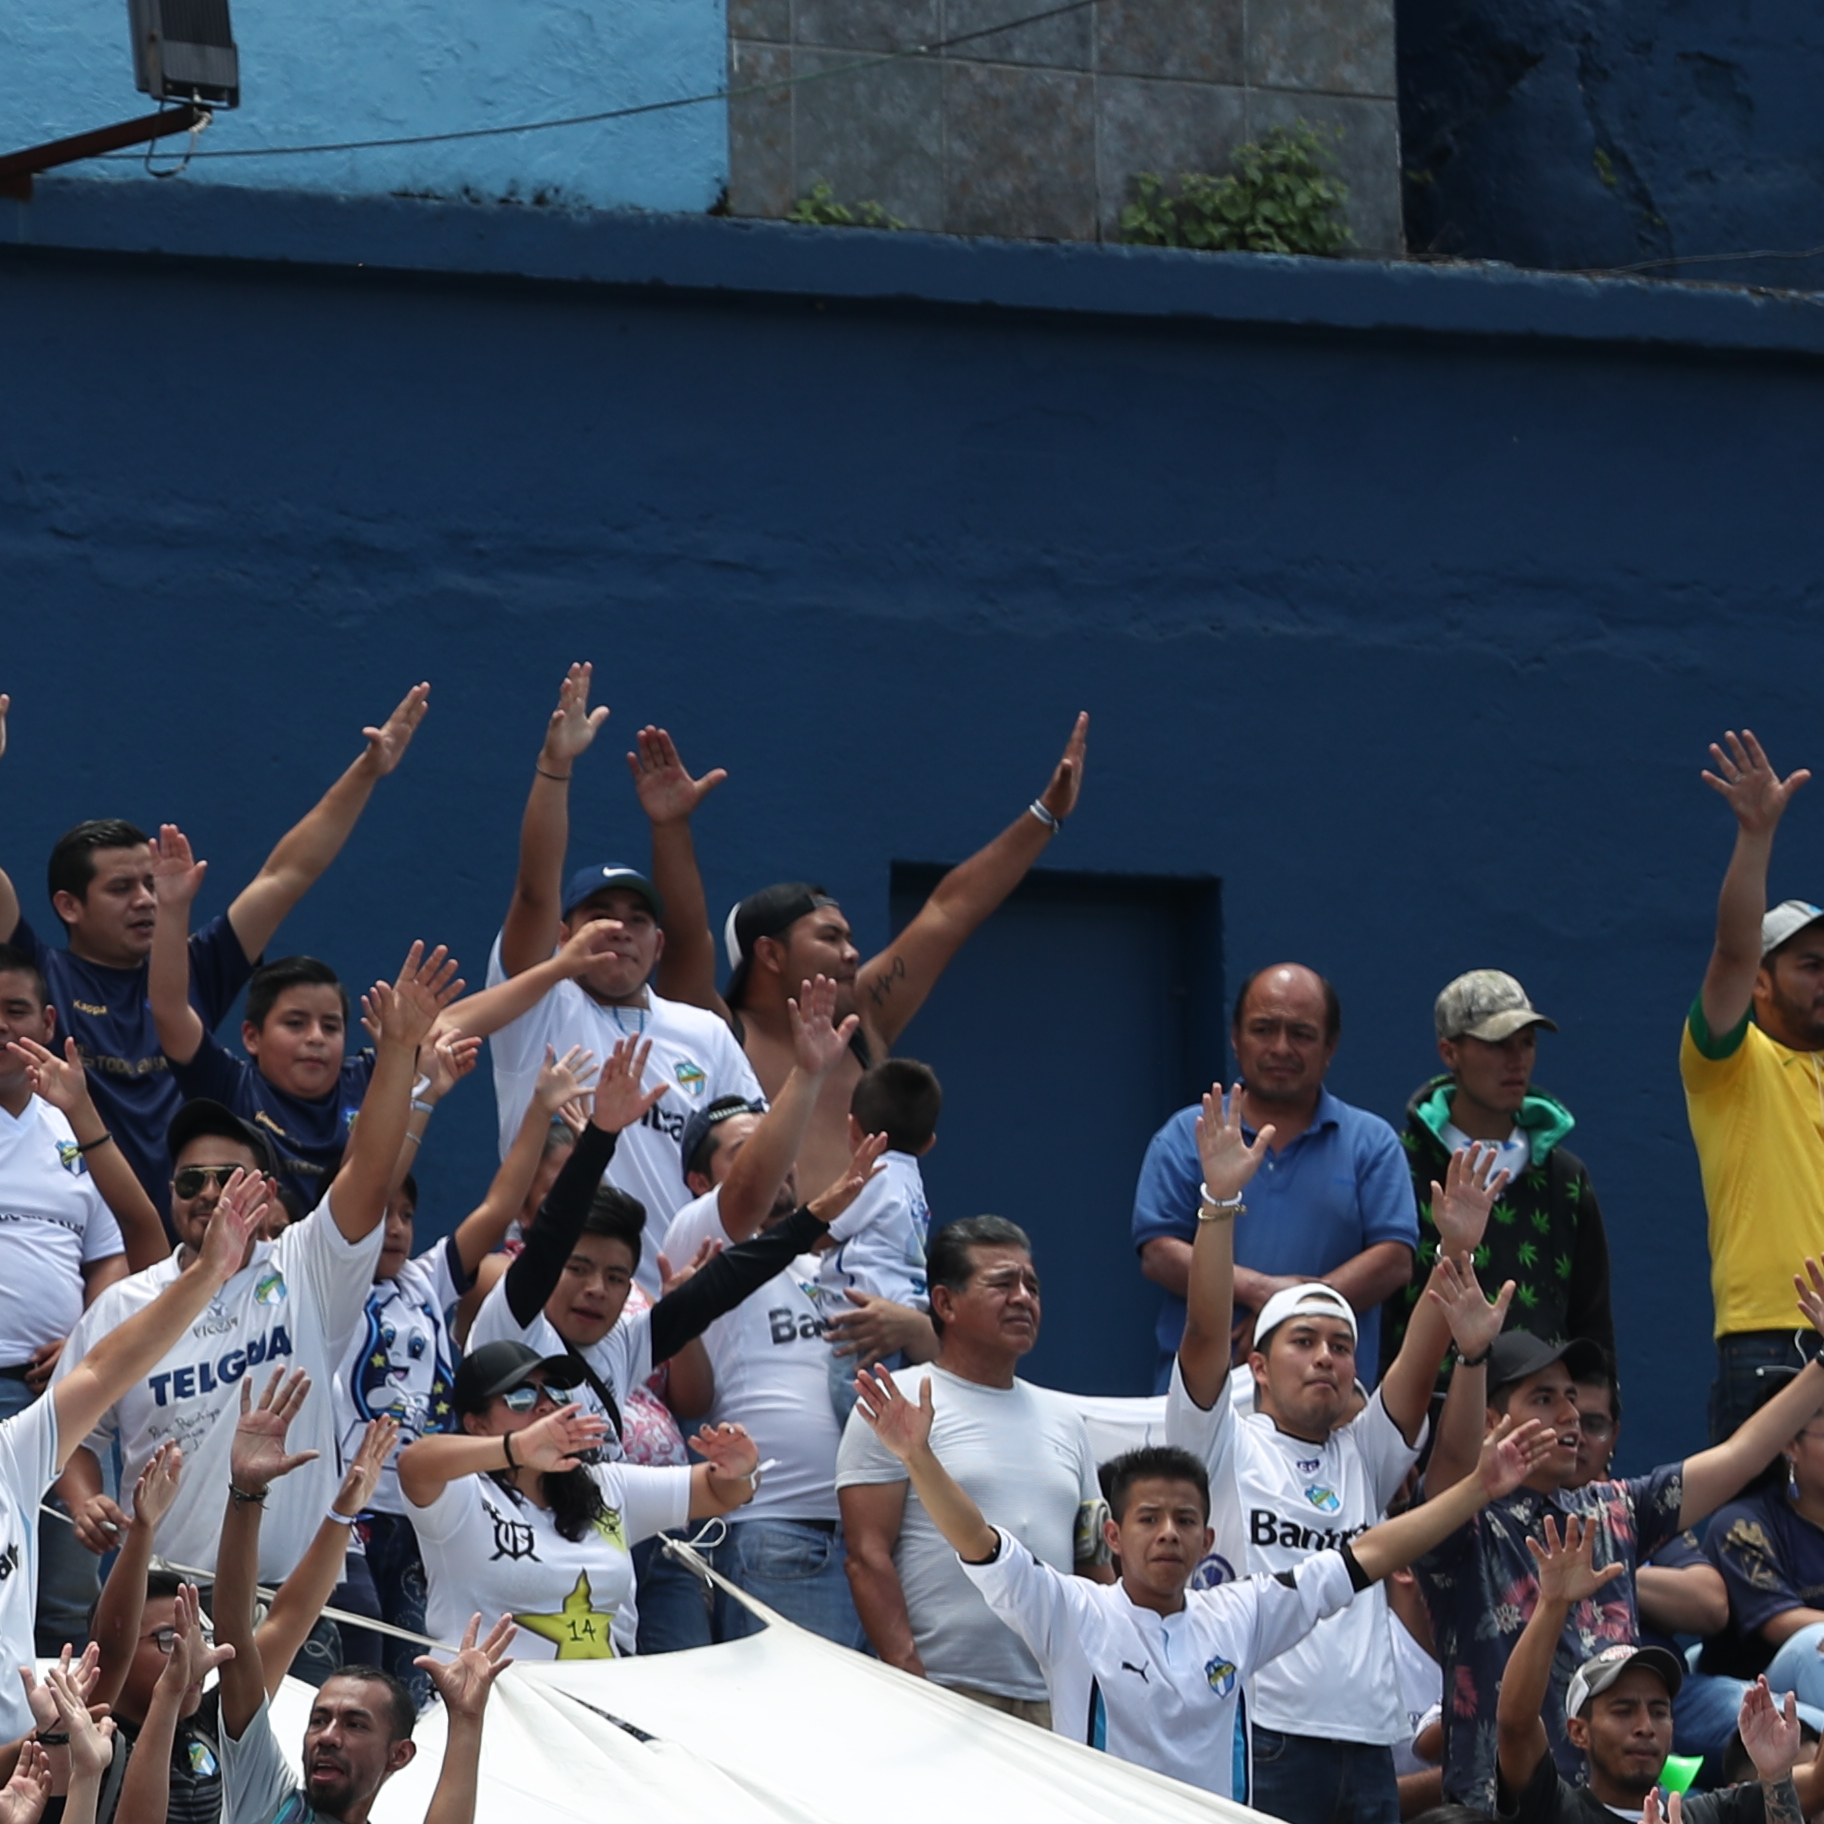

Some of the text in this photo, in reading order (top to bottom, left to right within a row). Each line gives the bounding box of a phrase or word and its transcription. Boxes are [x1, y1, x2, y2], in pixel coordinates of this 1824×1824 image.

[73, 999, 108, 1016] Kappa
[148, 1324, 294, 1407] TELGUA
[1250, 1507, 1370, 1552] Bantr
[565, 1619, 597, 1643] 14
